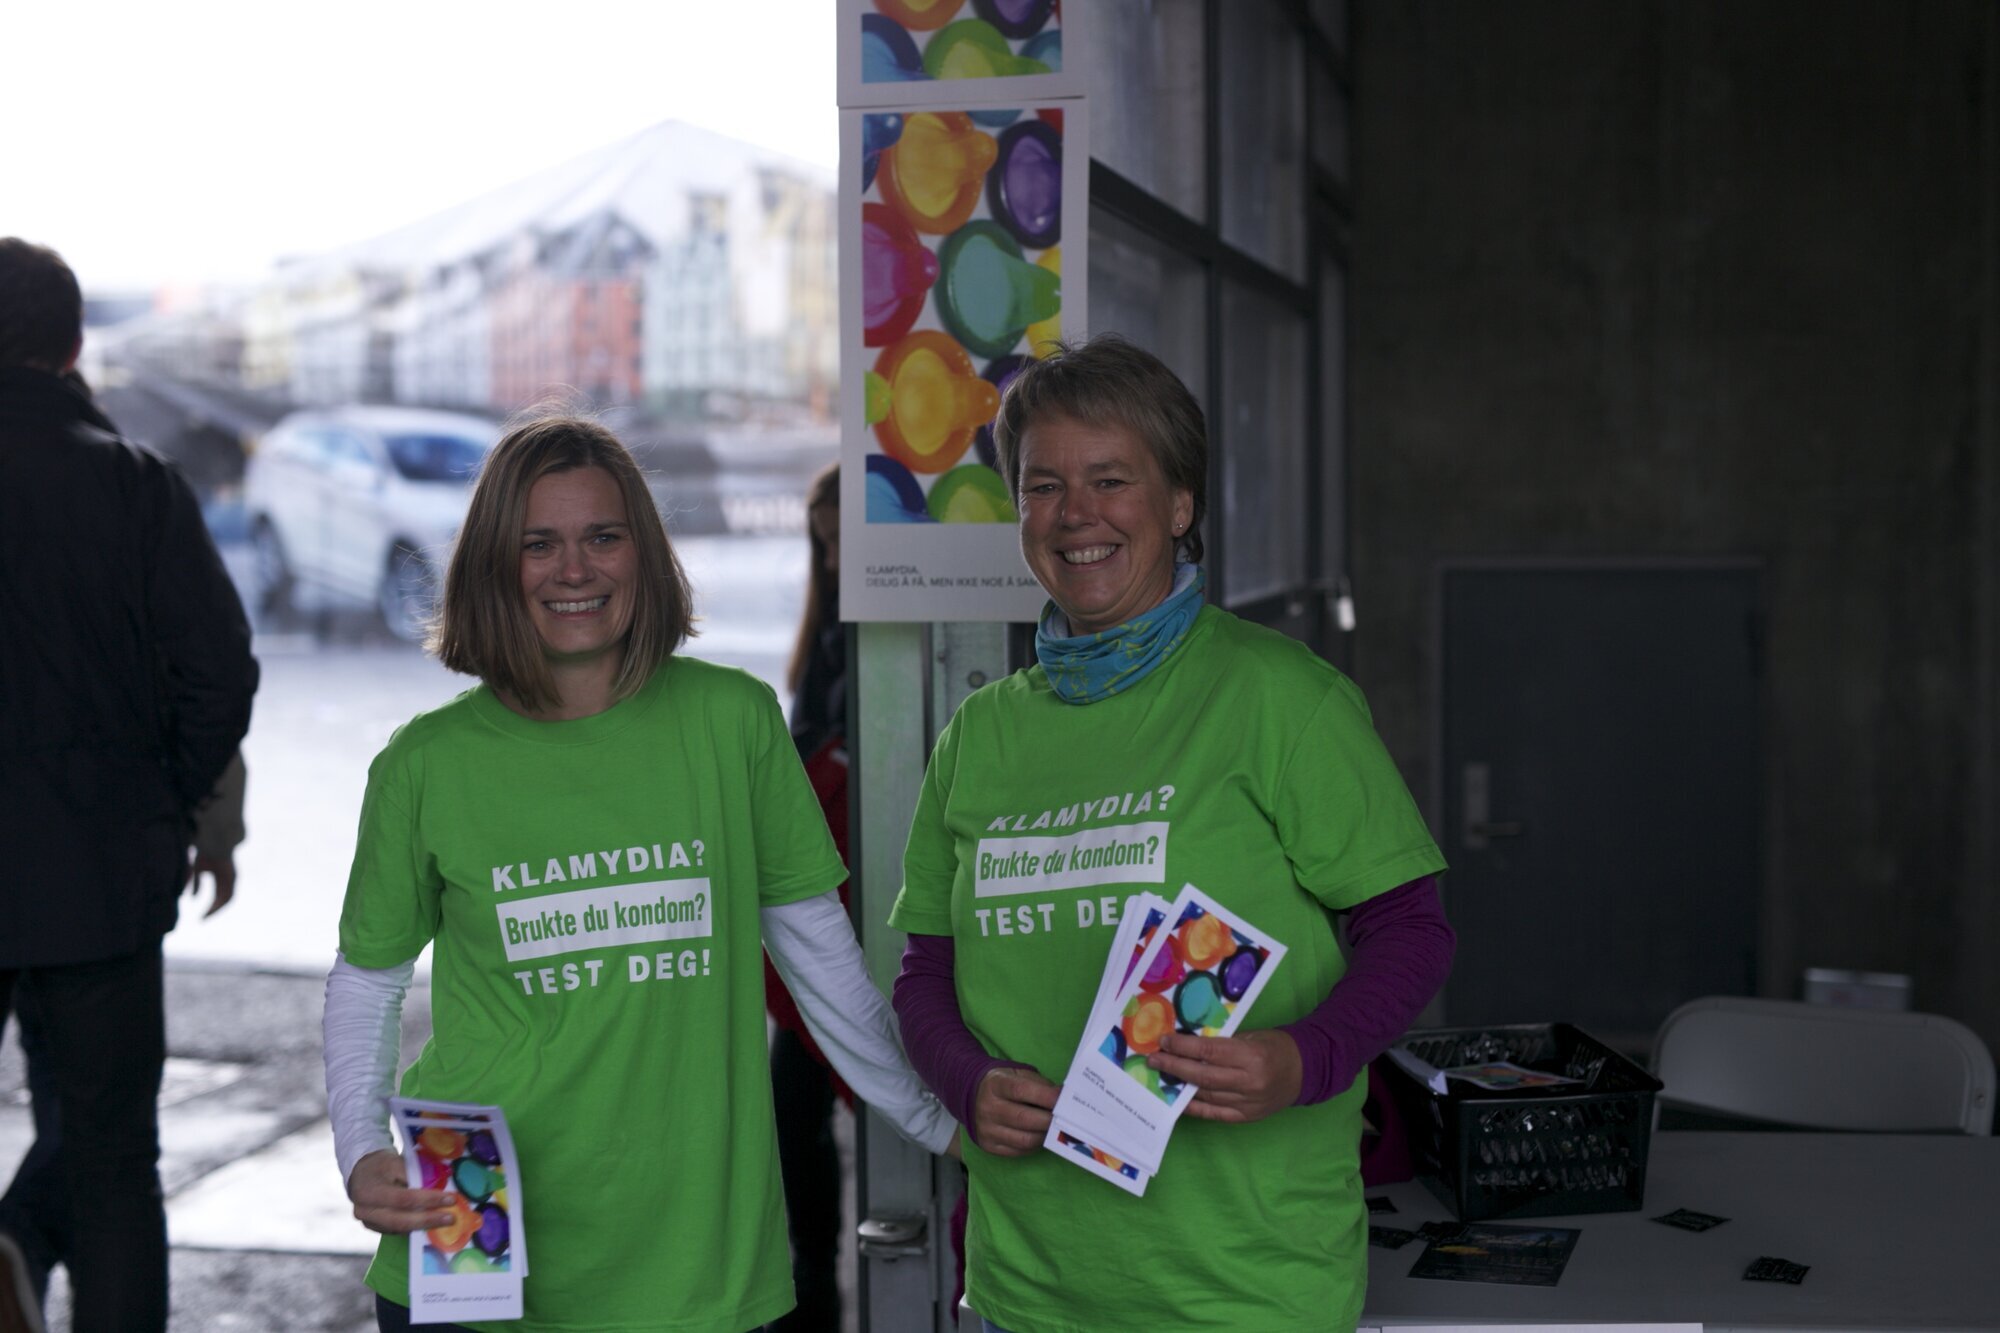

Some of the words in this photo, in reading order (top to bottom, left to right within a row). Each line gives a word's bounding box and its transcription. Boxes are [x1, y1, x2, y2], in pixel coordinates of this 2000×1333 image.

[930, 577, 954, 588] MEN
[956, 577, 978, 588] IKKE
[981, 577, 1003, 588] NOE
[1016, 577, 1038, 588] SAM
[986, 784, 1176, 831] KLAMYDIA?
[492, 839, 705, 892] KLAMYDIA?
[980, 850, 1040, 880] Brukte
[1043, 849, 1067, 874] du
[1069, 835, 1160, 871] kondom?
[505, 910, 577, 945] Brukte
[583, 904, 609, 933] du
[614, 892, 706, 929] kondom?
[975, 903, 1055, 937] TEST
[1077, 896, 1141, 929] DE
[514, 959, 604, 995] TEST
[628, 949, 710, 983] DEG!
